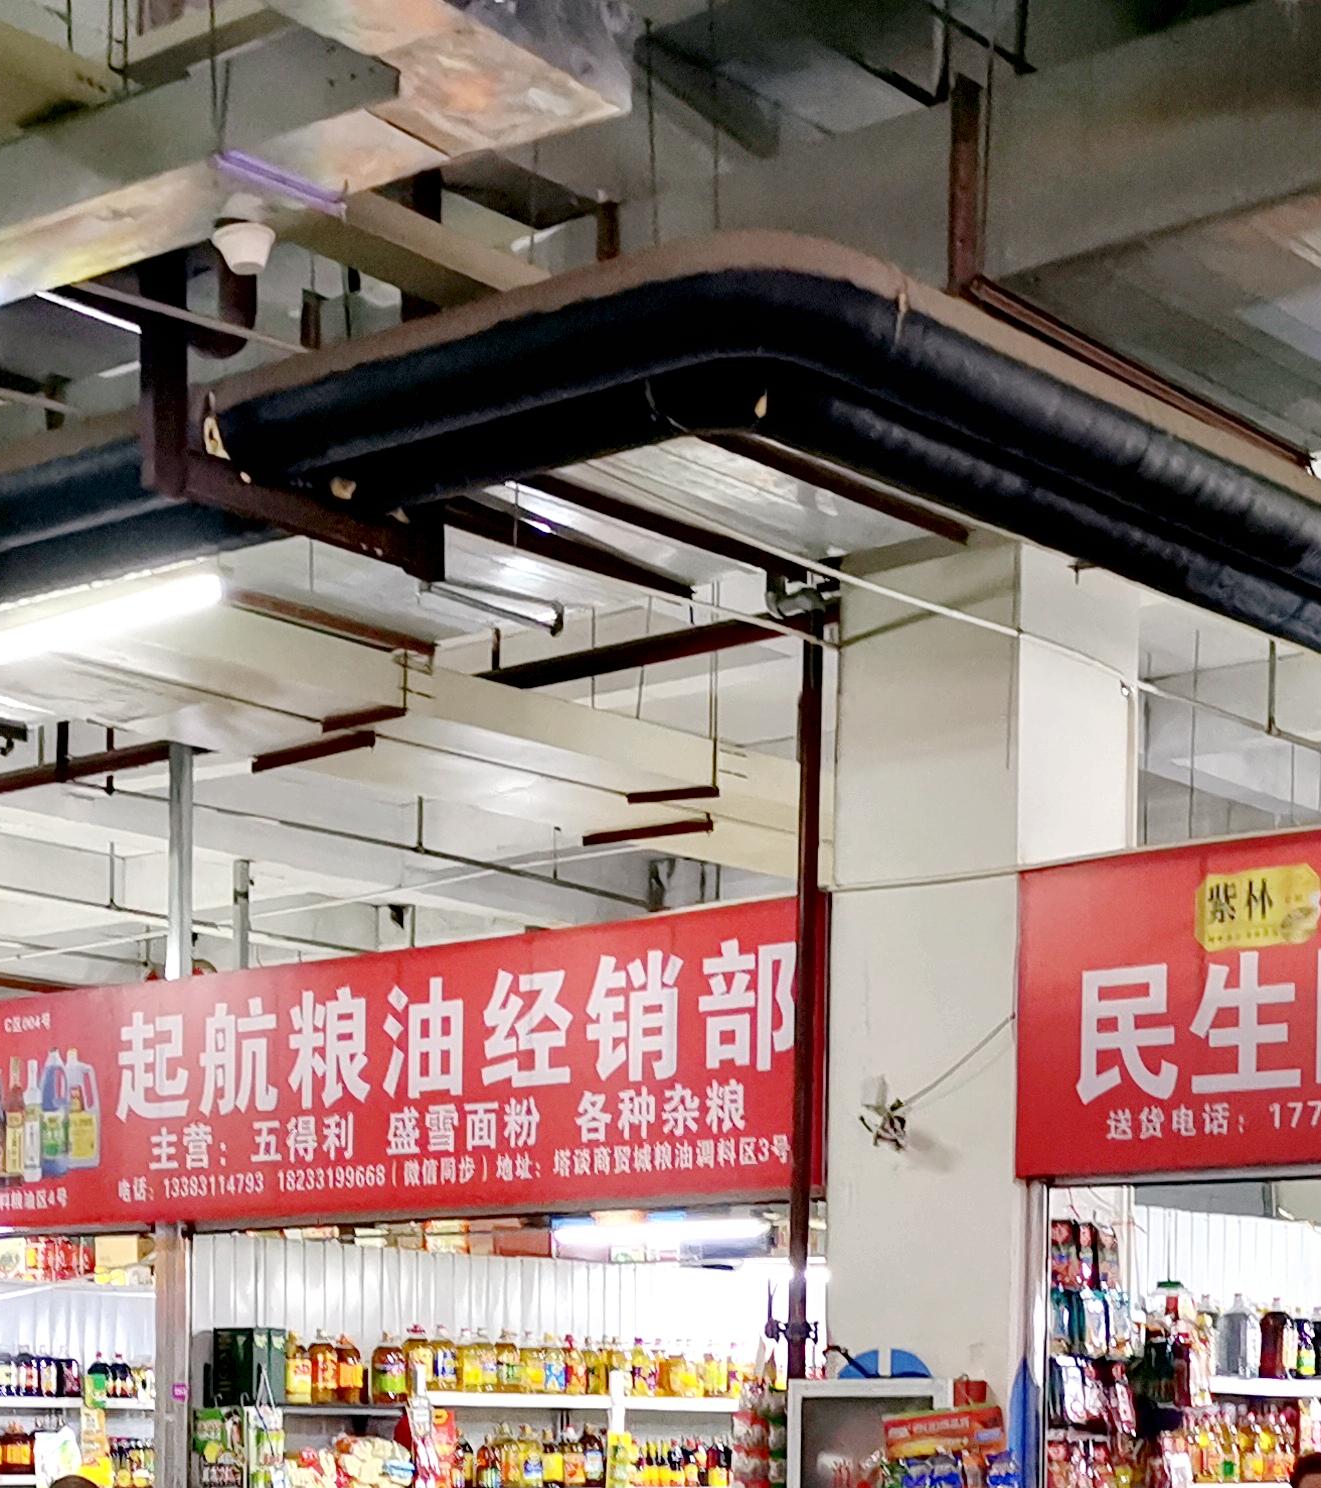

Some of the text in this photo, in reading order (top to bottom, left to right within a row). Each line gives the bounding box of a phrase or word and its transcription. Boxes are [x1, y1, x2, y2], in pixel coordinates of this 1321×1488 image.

[115, 937, 798, 1121] 起航粮油经销部
